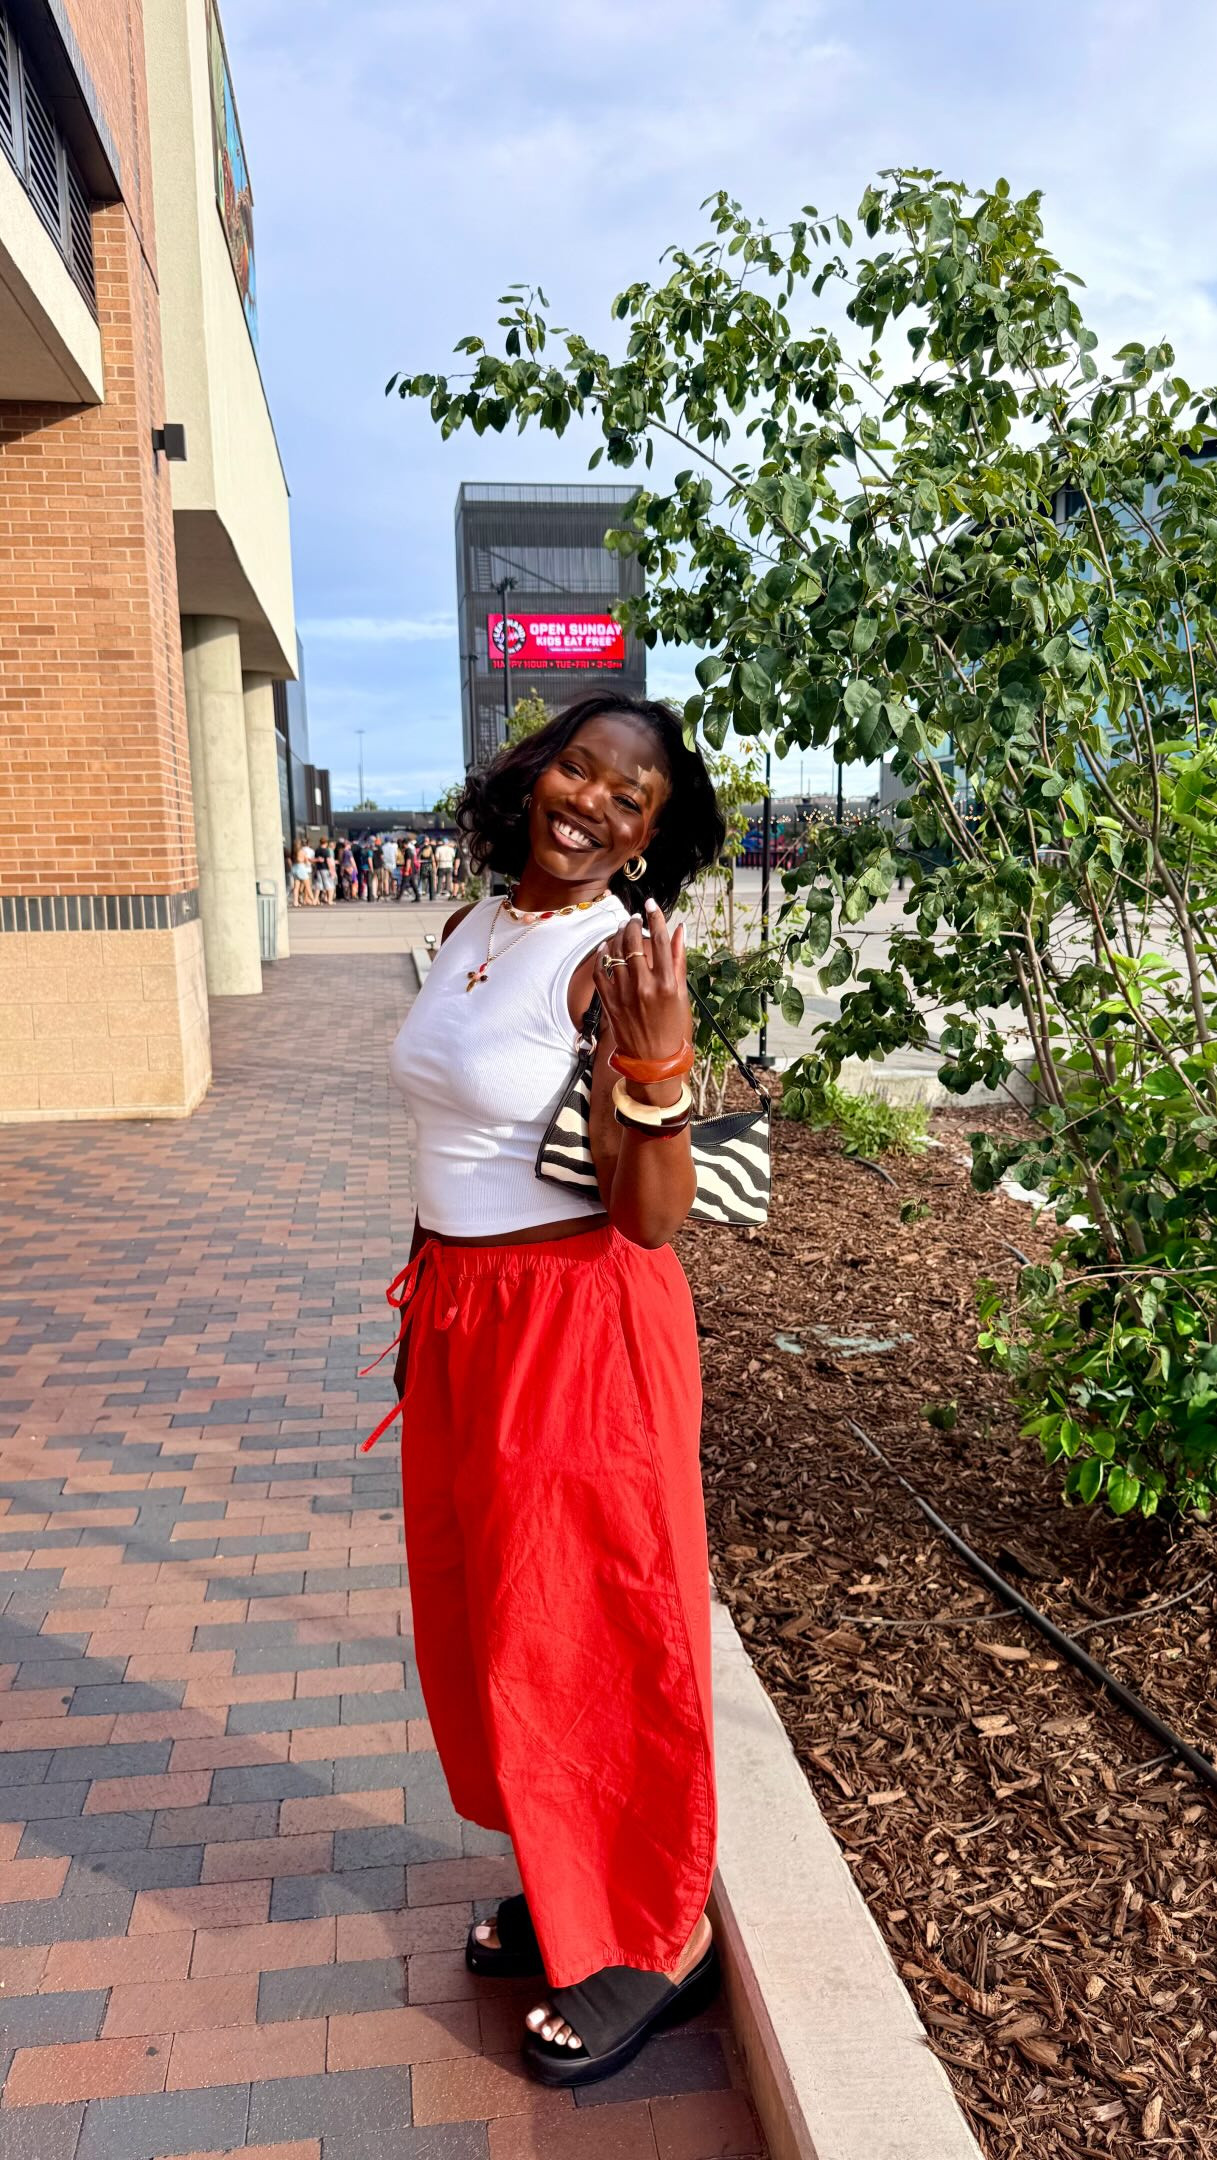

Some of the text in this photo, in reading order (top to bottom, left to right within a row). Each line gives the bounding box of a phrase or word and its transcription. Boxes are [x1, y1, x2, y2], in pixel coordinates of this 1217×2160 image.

[529, 623, 622, 635] OPEN SUNDAY
[536, 636, 561, 646] KIDS
[564, 636, 583, 646] EAT
[493, 660, 521, 668] HAPY
